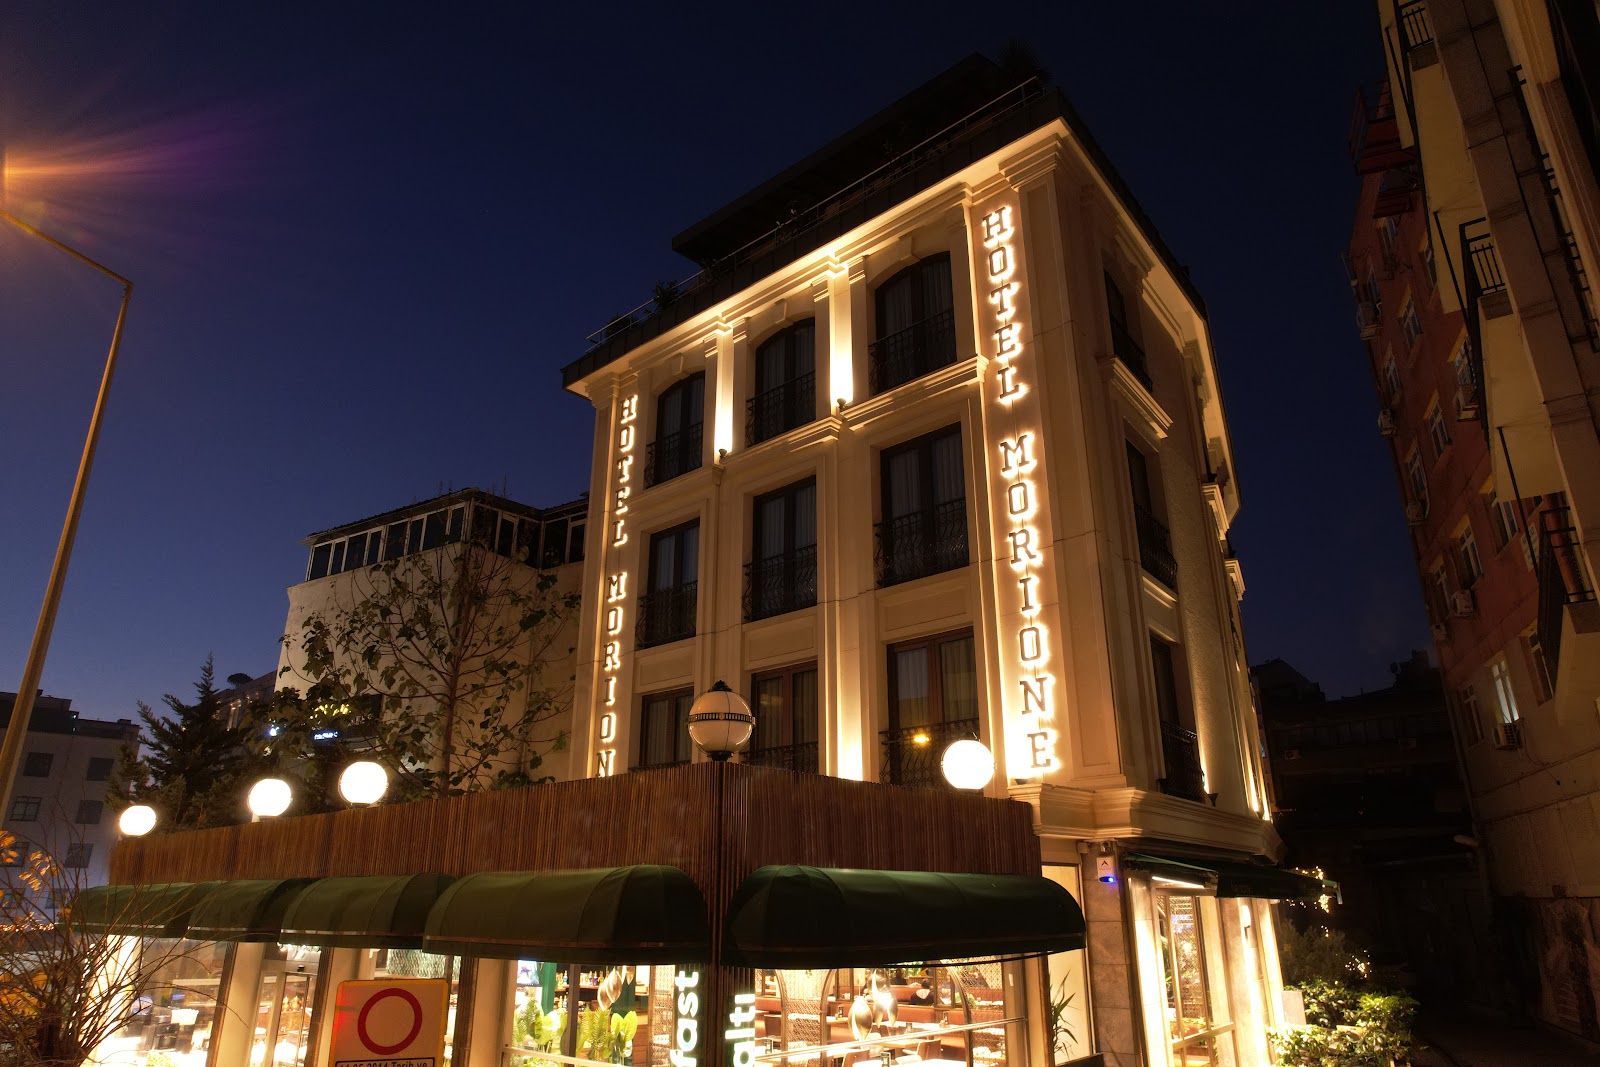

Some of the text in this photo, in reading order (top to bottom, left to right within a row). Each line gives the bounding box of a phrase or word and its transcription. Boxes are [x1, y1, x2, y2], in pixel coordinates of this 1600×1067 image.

[612, 394, 638, 547] HOTEL
[981, 205, 1056, 772] HOTEL MORIONE
